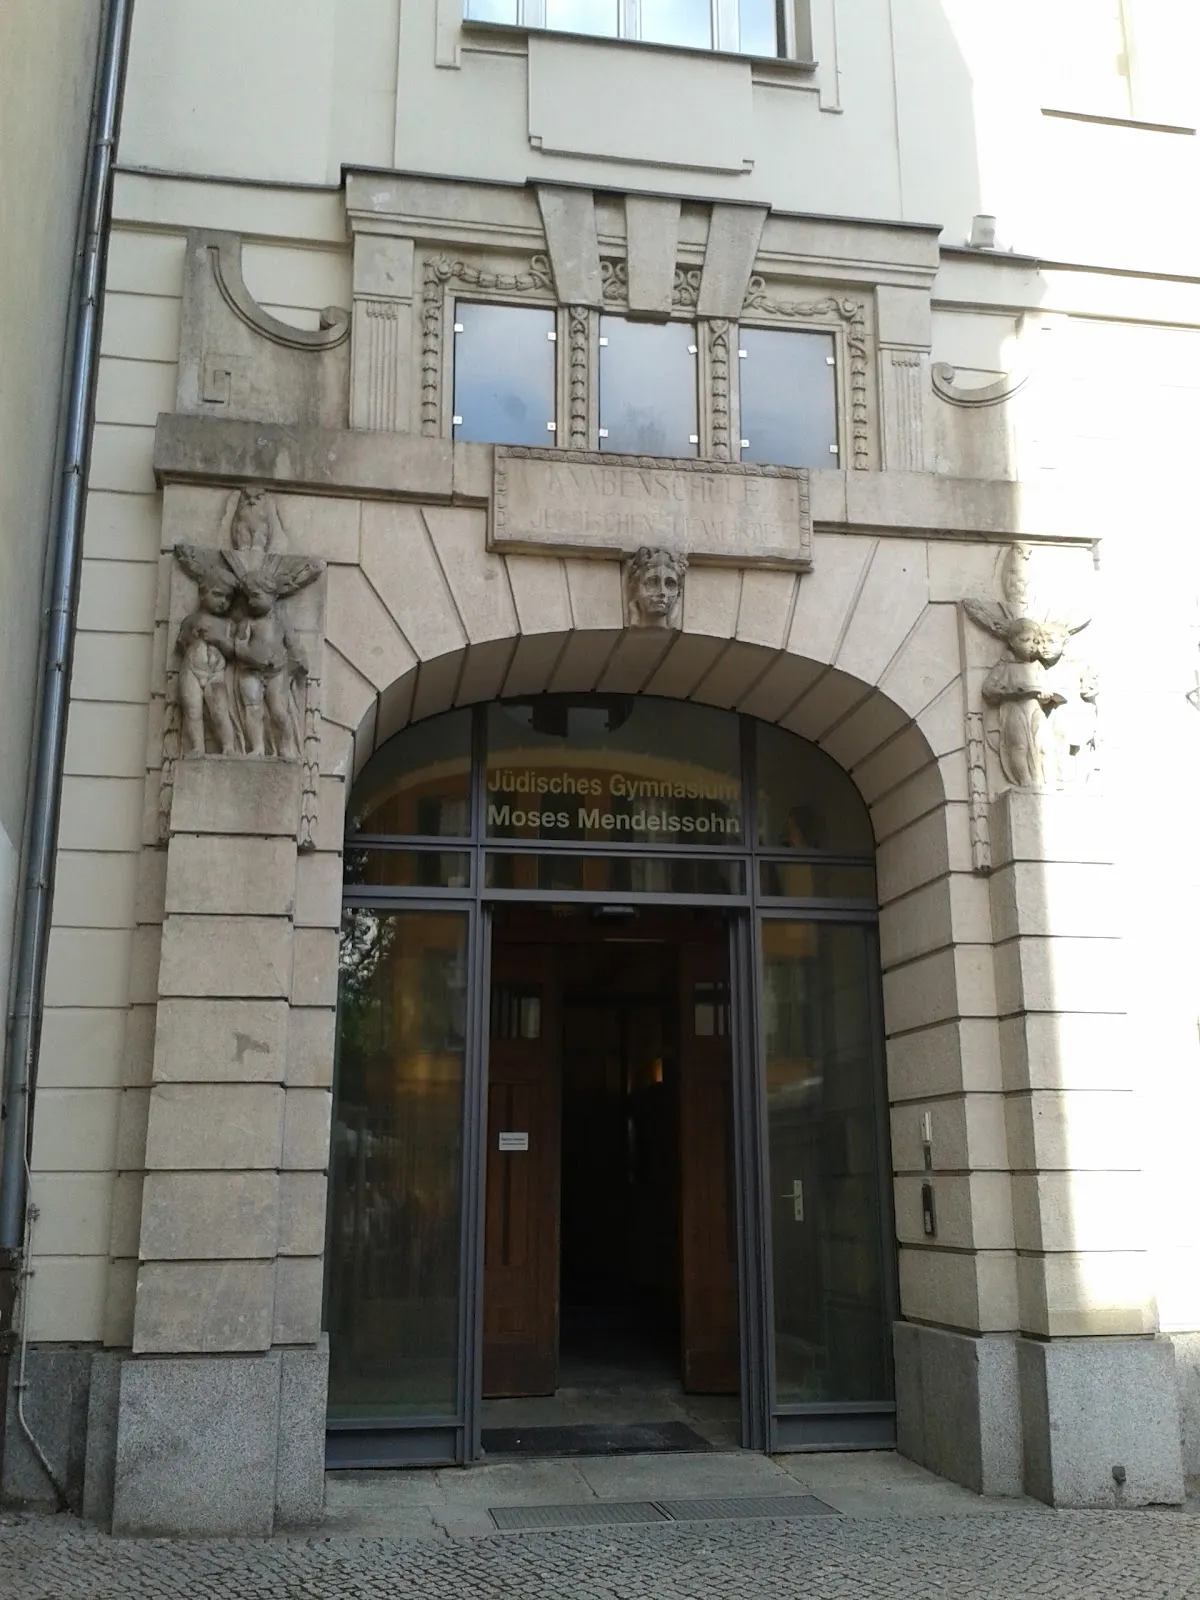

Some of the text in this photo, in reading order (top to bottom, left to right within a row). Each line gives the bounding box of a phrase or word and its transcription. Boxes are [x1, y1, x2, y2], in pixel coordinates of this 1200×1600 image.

[486, 767, 741, 801] Jüdisches Gymnasium
[487, 804, 741, 833] Moses Mendelssohn
